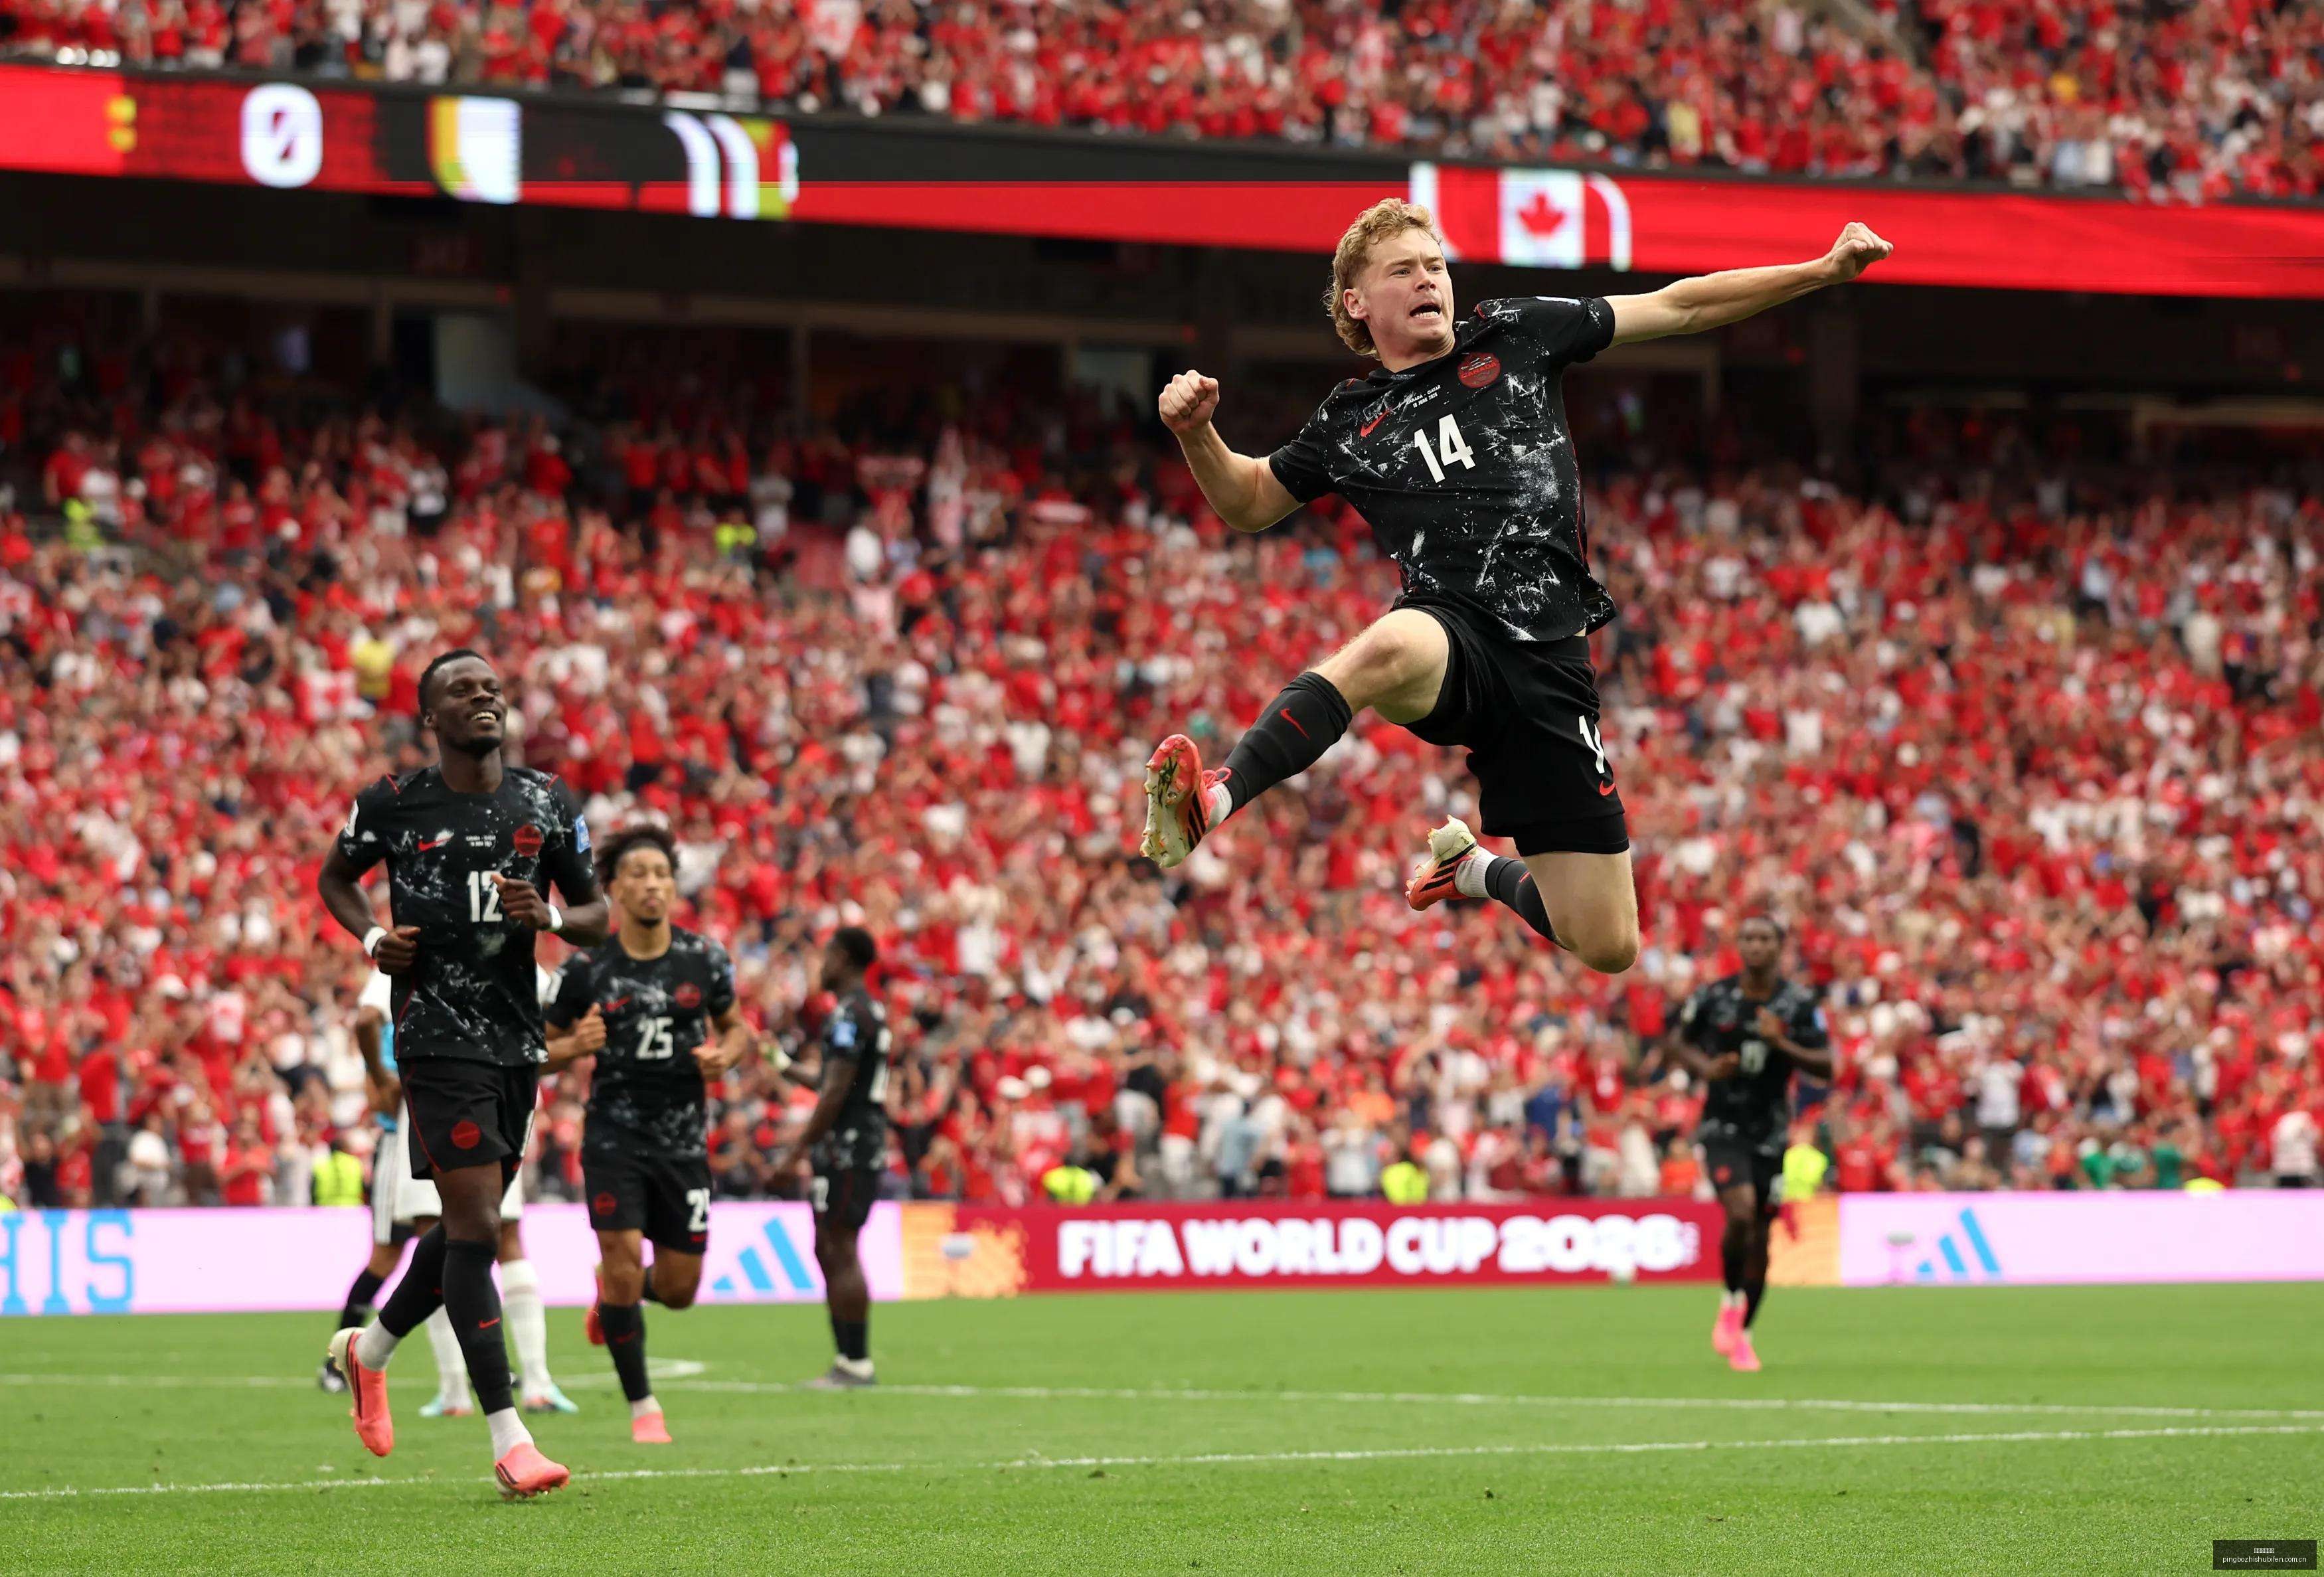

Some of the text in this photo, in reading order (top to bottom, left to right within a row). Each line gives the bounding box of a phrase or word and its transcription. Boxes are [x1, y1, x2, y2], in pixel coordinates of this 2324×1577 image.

[240, 83, 323, 188] 0
[1414, 414, 1475, 483] 14
[467, 871, 503, 922] 12
[636, 1017, 674, 1060] 25
[686, 1187, 710, 1232] 2
[1058, 1219, 1184, 1278] FIFA
[1183, 1217, 1383, 1276] WORLD
[1386, 1216, 1498, 1274] CUP
[1498, 1214, 1684, 1273] 2026
